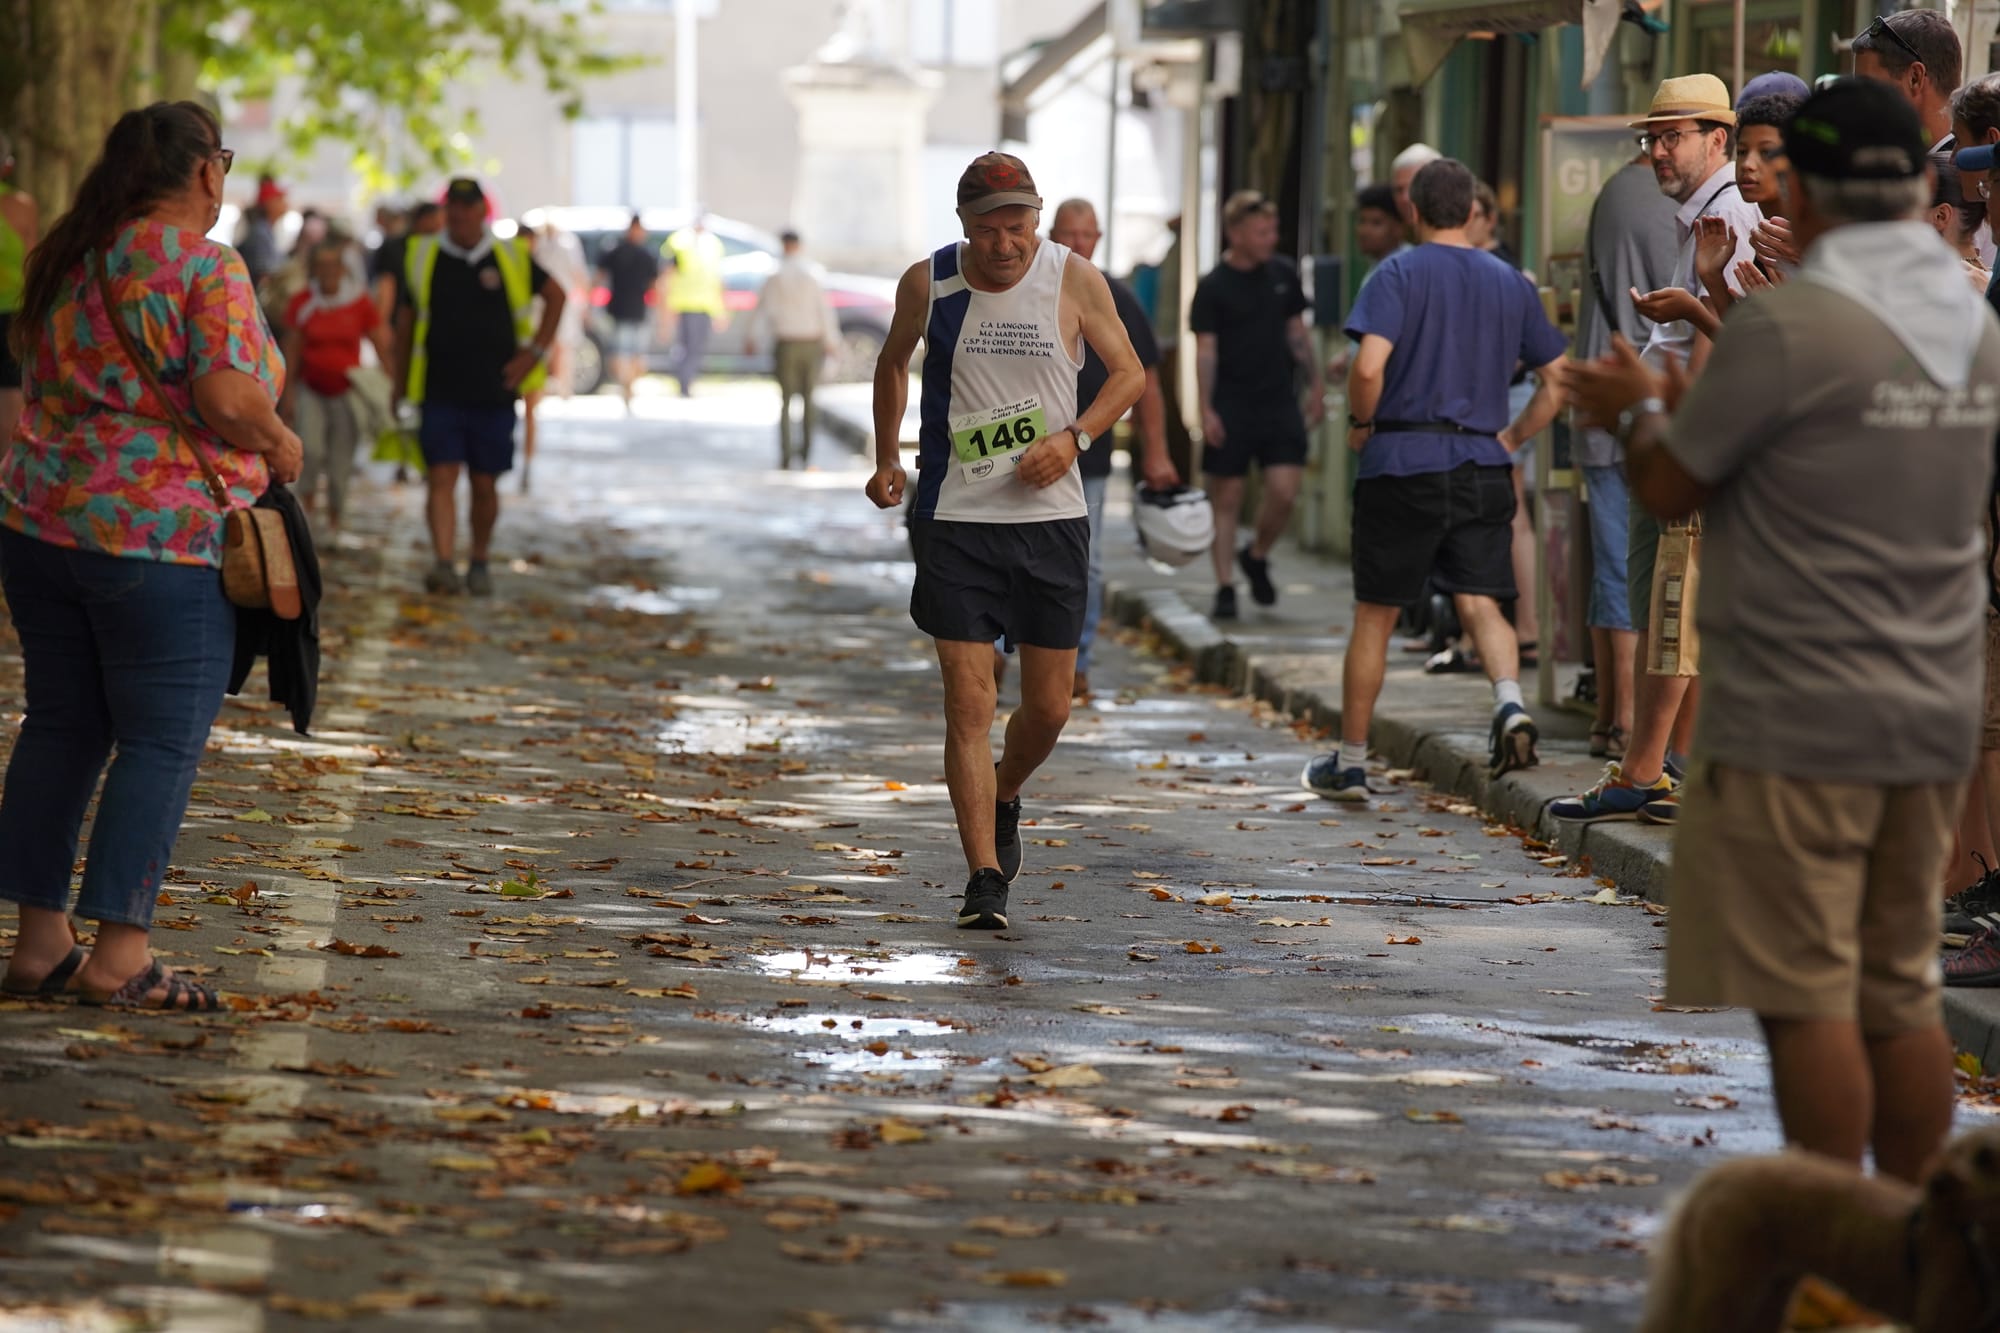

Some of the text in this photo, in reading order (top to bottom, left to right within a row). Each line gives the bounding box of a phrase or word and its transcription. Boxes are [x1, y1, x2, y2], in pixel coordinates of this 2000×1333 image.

[1559, 158, 1602, 195] GL
[997, 322, 1039, 330] LANGOGNE
[995, 331, 1040, 339] MARVEJOLS
[992, 339, 1016, 347] CHELY
[1019, 341, 1054, 349] D'APCHER
[990, 348, 1026, 356] MENDOIS
[969, 417, 1036, 457] 146
